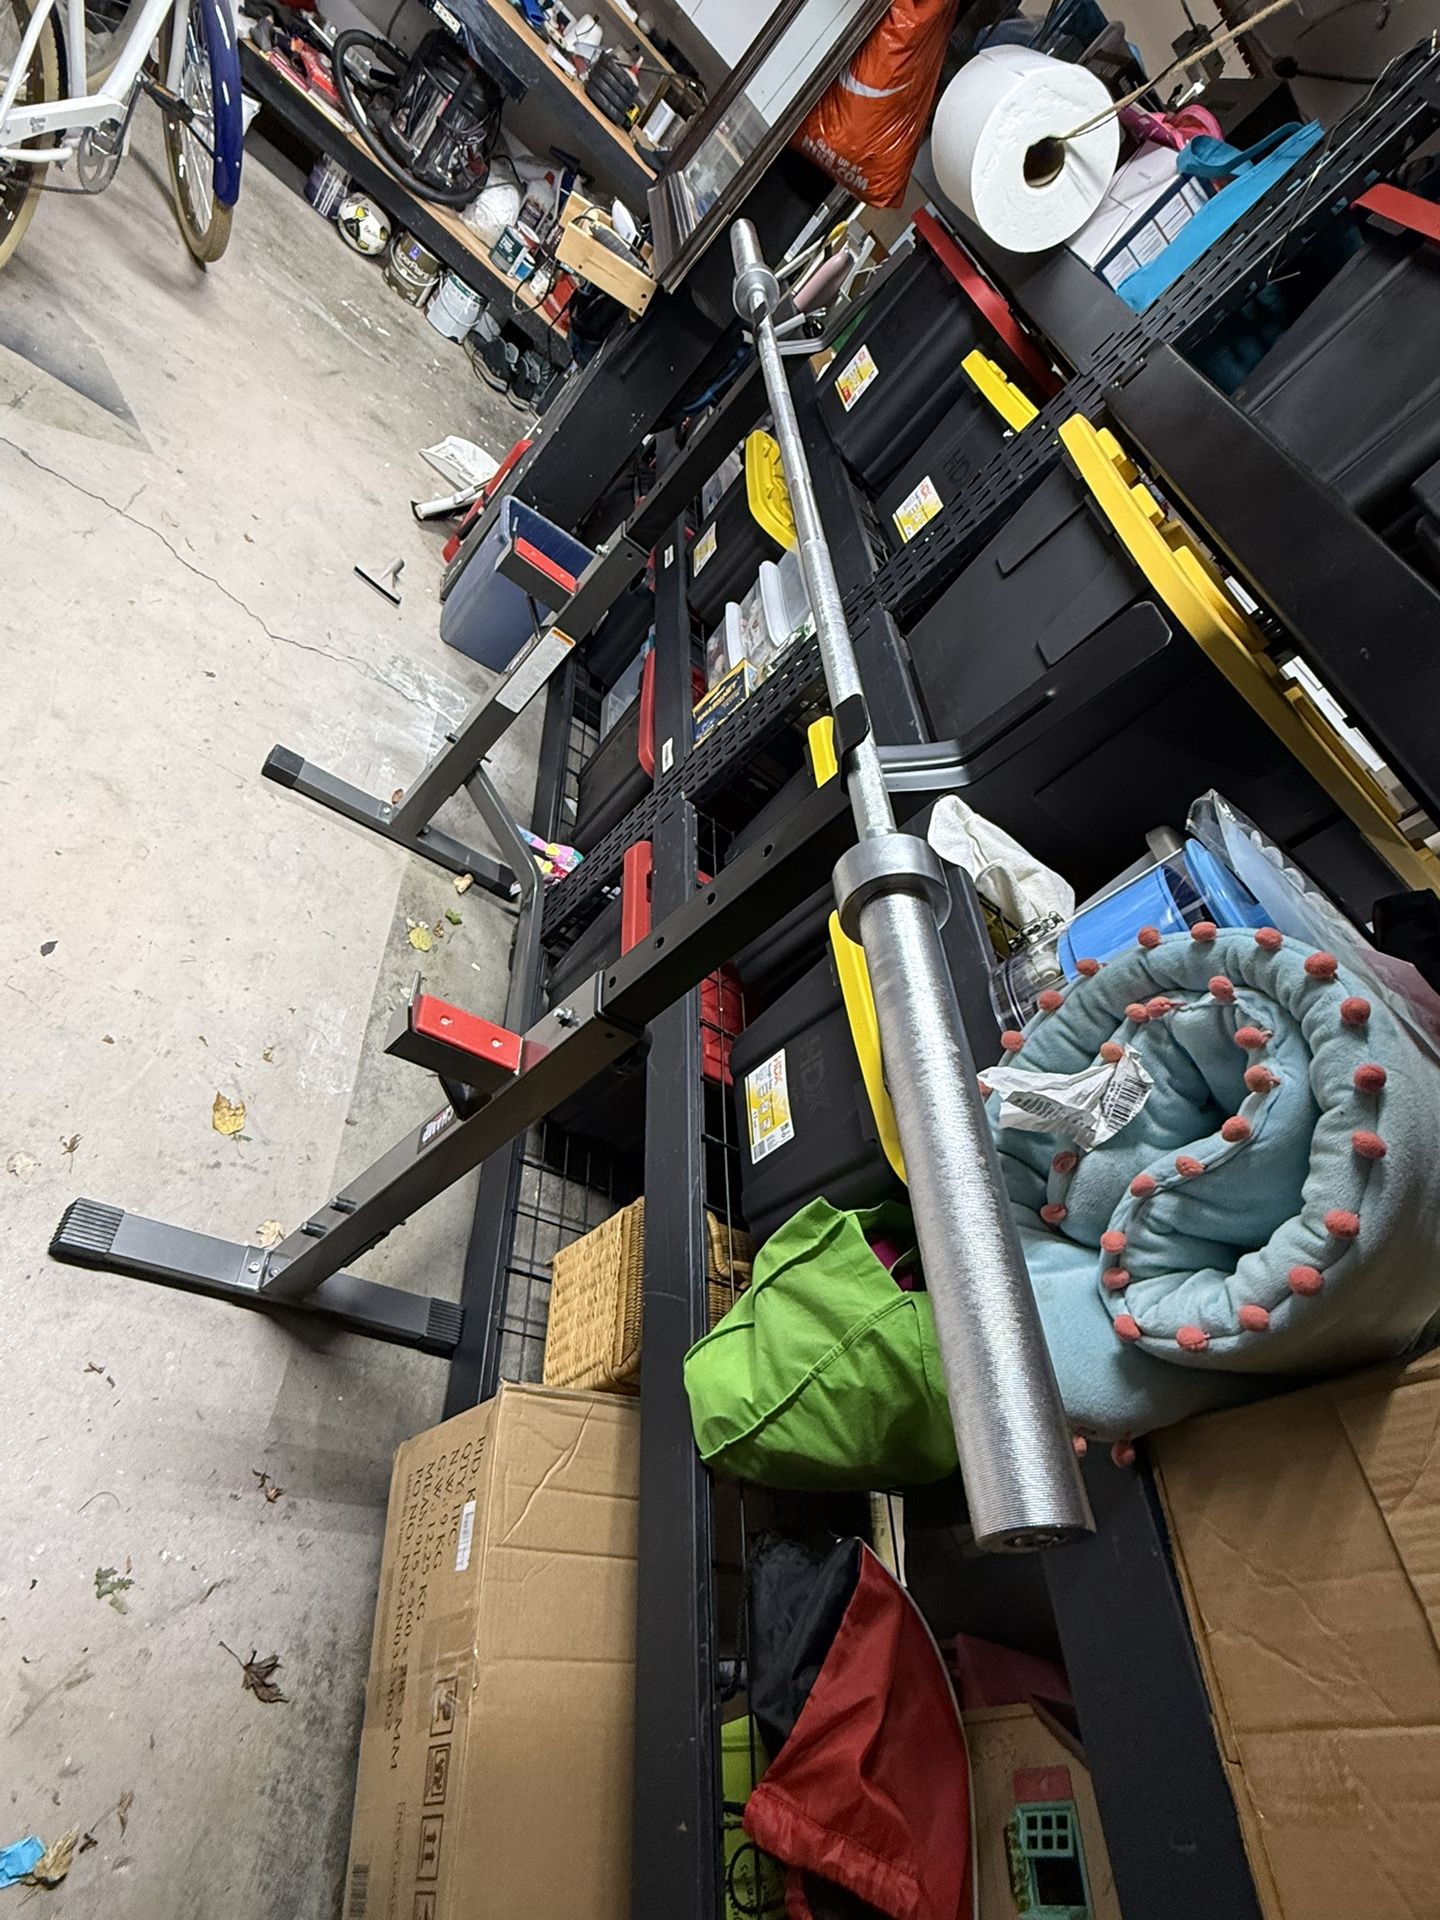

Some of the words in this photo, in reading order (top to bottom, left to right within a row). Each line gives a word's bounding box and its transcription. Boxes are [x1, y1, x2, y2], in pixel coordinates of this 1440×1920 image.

[837, 156, 851, 168] UP
[455, 1442, 474, 1496] QTY:
[468, 1435, 487, 1481] PID:
[412, 1464, 425, 1498] PO
[416, 1461, 436, 1529] MEAS:
[440, 1513, 449, 1526] 9
[411, 1533, 422, 1572] 915
[422, 1521, 437, 1576] 12.25
[432, 1533, 446, 1570] KG
[416, 1584, 428, 1621] KG
[390, 1717, 402, 1770] MM
